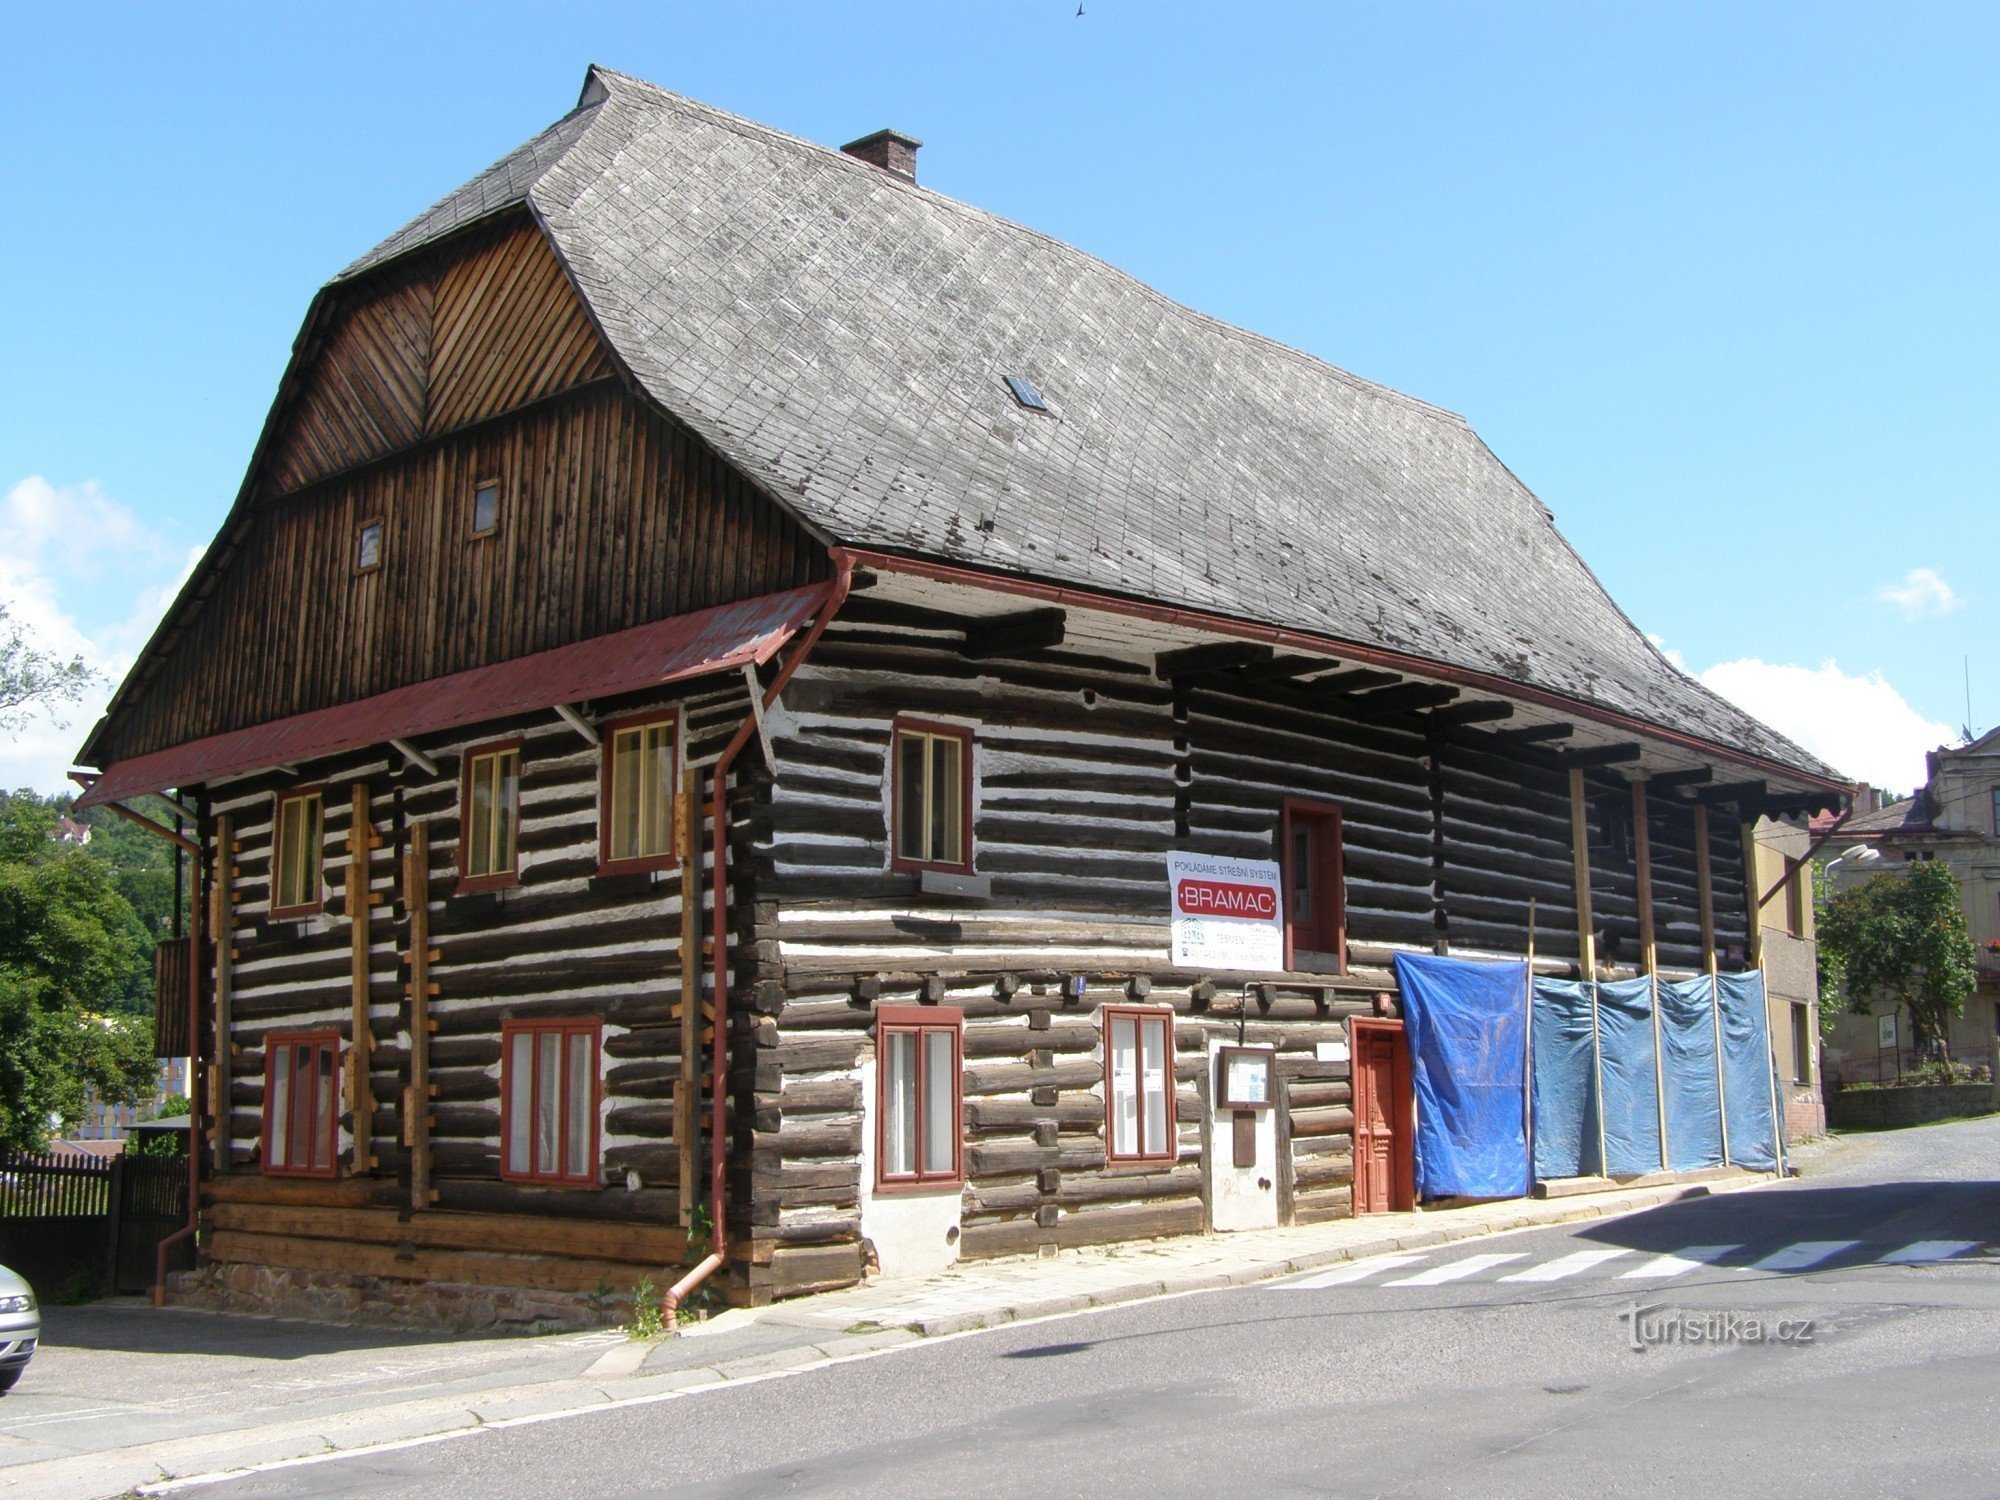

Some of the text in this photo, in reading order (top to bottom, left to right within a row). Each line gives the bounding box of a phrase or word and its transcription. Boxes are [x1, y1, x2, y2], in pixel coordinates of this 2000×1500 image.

[1174, 861, 1277, 880] POKLÁDÁME STŘEŠNÍ SYSTÉM
[1184, 886, 1272, 913] BRAMAC
